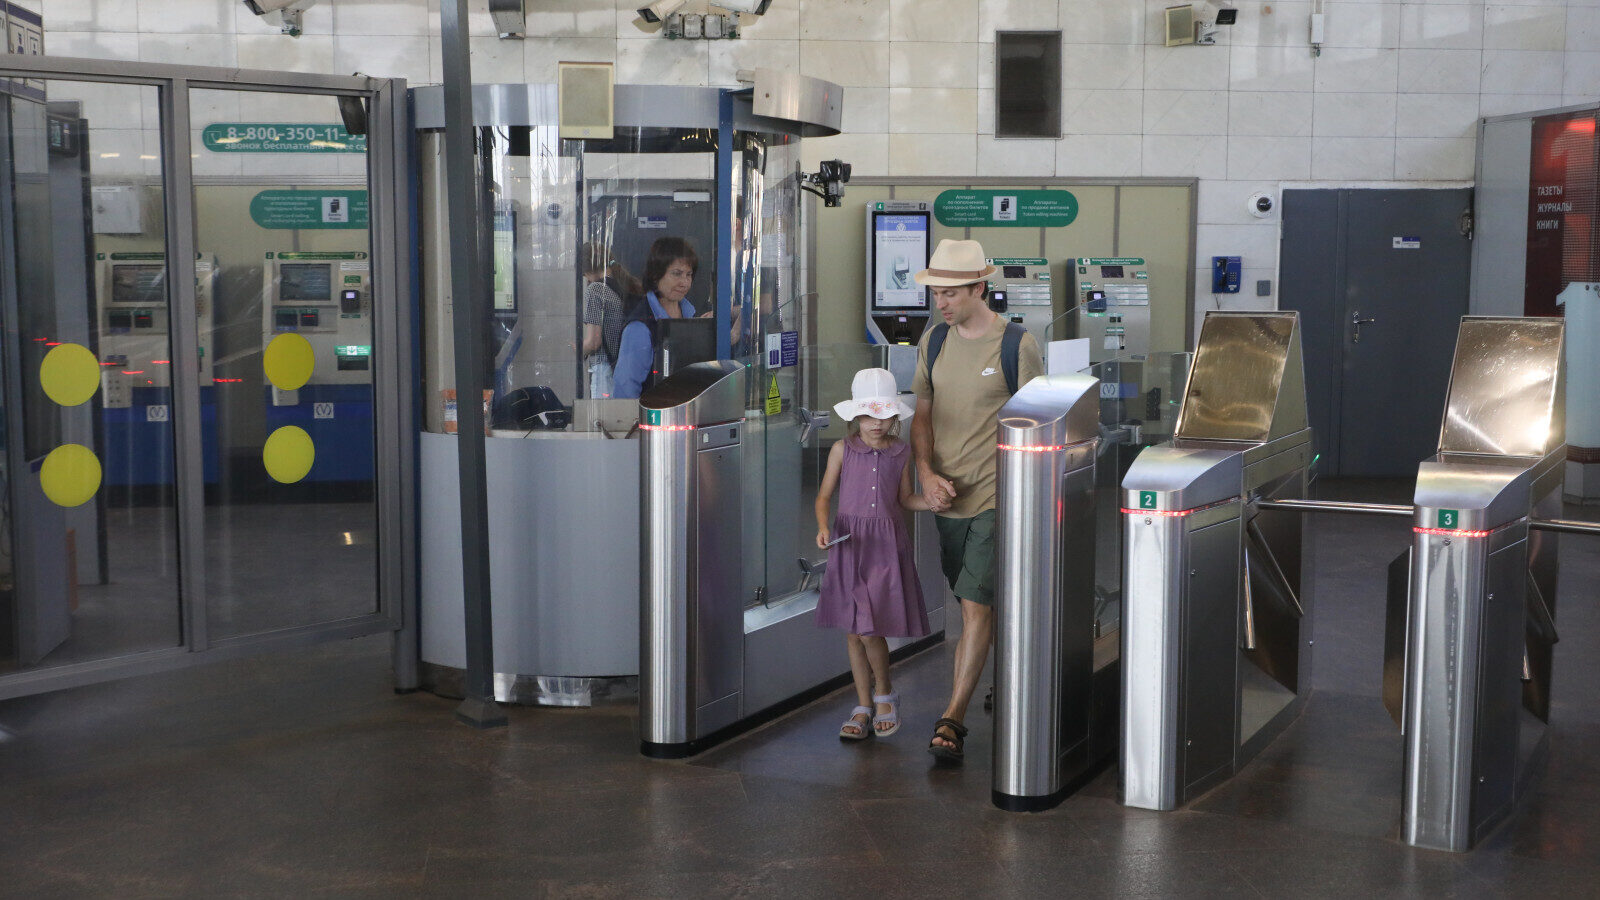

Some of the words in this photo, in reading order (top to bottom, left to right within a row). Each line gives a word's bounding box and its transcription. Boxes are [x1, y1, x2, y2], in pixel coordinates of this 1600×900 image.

[1537, 185, 1563, 196] ГАЗЕТЫ
[1537, 202, 1572, 212] ЖУРНАЛЫ
[1536, 219, 1559, 230] КНИГИ
[651, 412, 656, 424] 1
[1144, 494, 1152, 506] 2
[1444, 513, 1452, 526] 3
